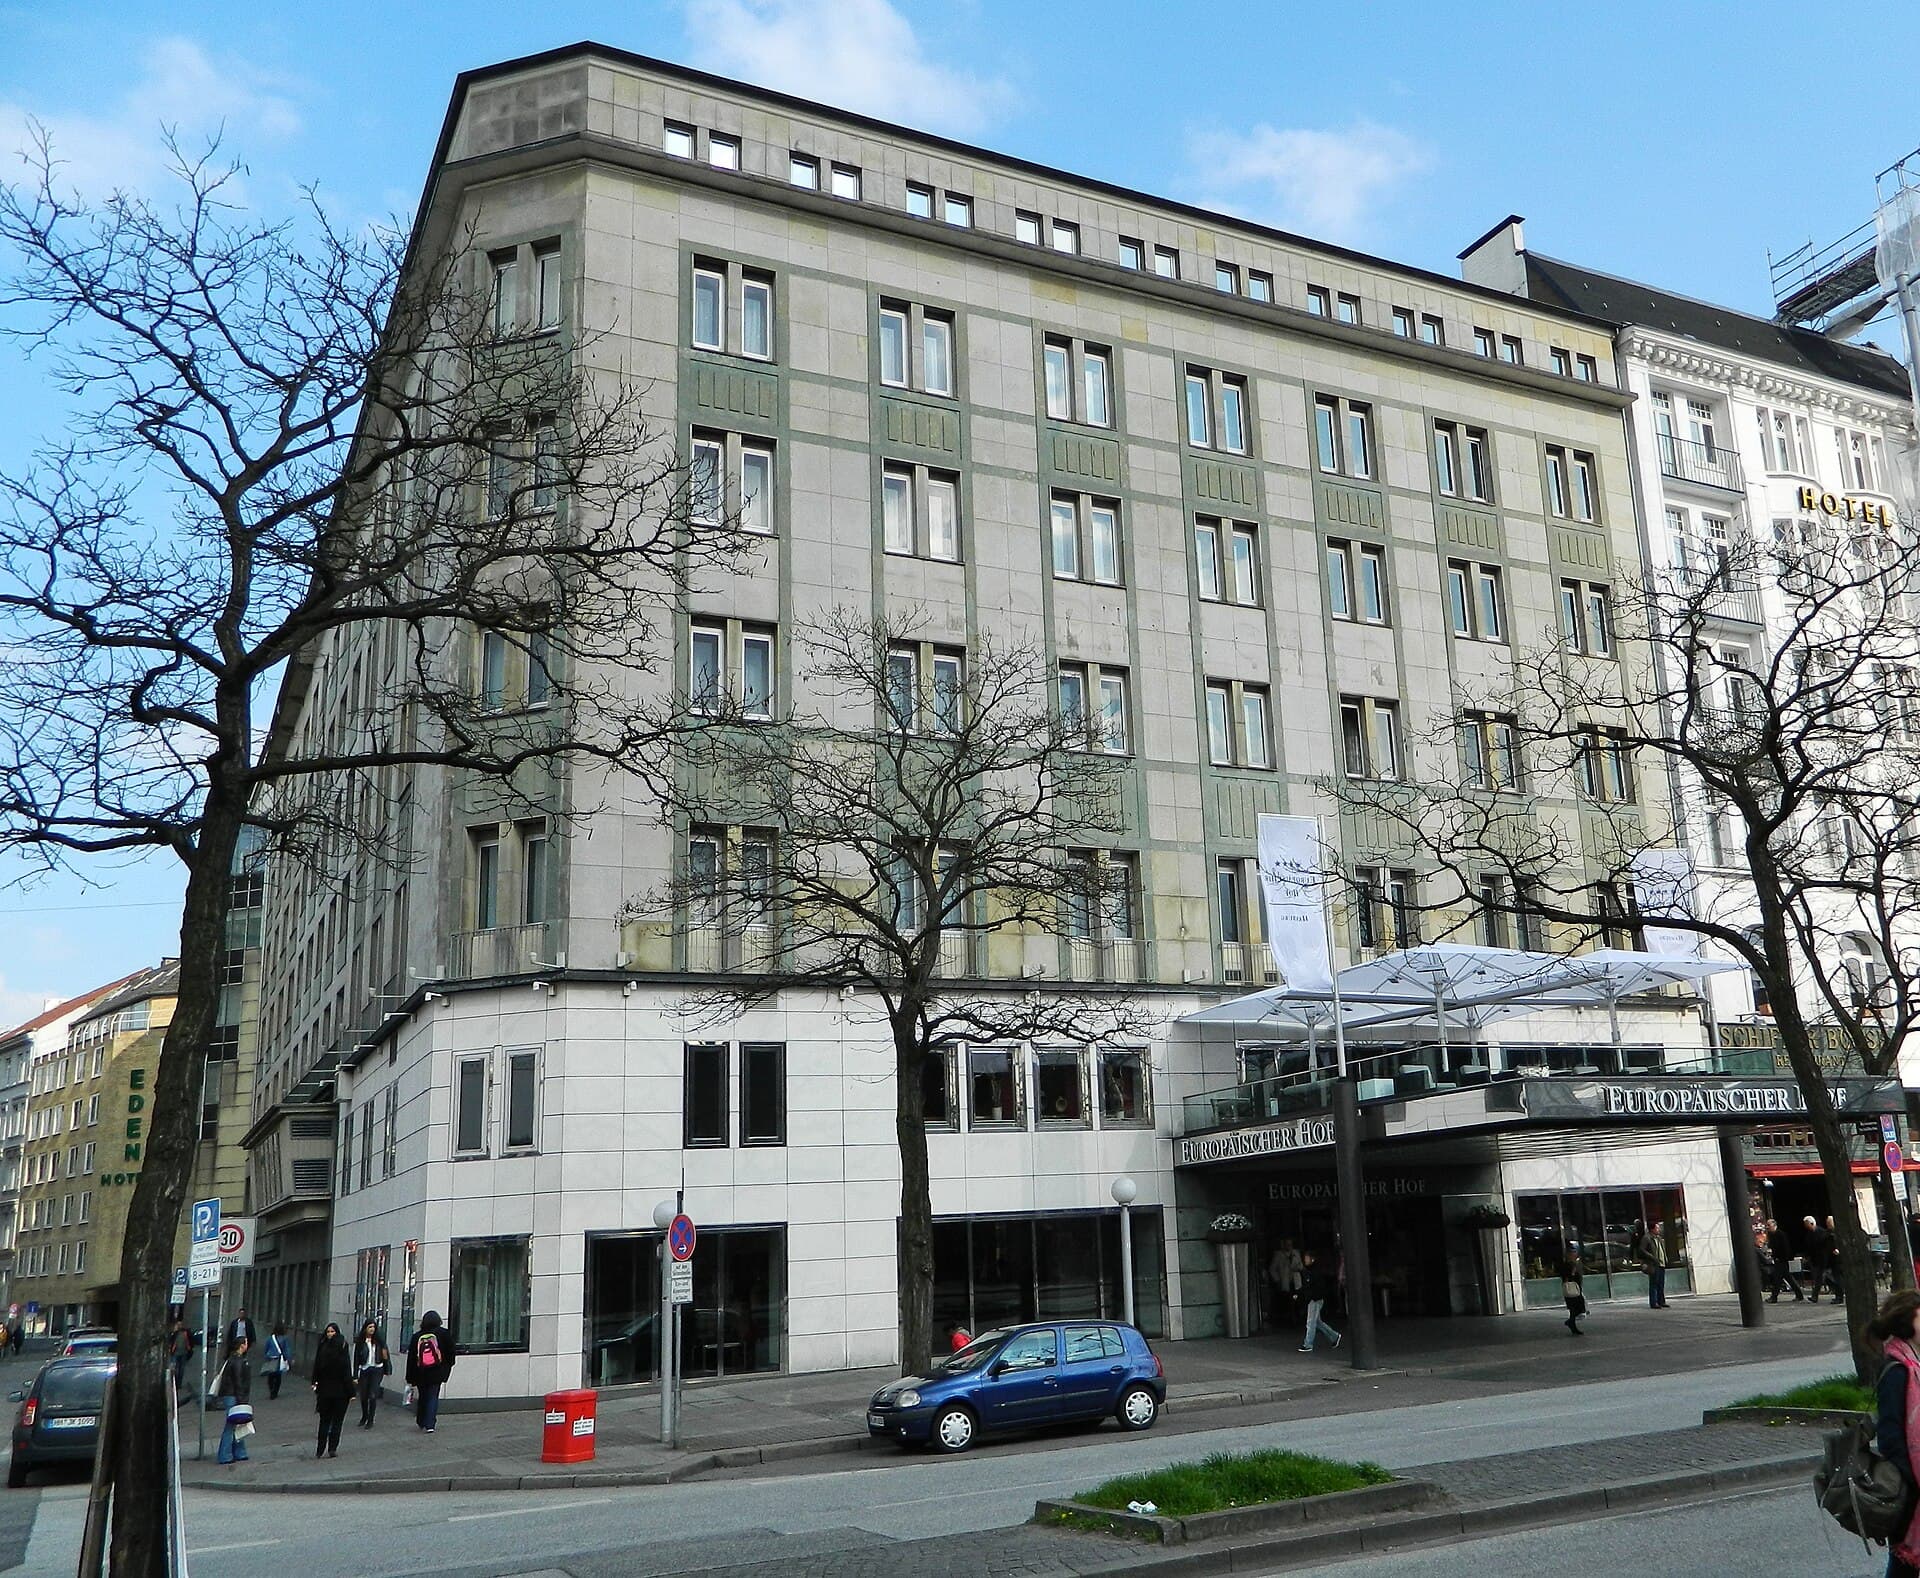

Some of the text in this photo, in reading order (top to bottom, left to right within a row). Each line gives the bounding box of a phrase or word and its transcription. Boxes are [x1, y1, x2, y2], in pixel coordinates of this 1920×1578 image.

[1798, 486, 1892, 527] HOTEL
[124, 1069, 145, 1162] EDEN
[1605, 1083, 1792, 1114] EUROPÄISCHER
[1181, 1127, 1294, 1163] EUROPÄISCHER
[220, 1231, 237, 1246] 30
